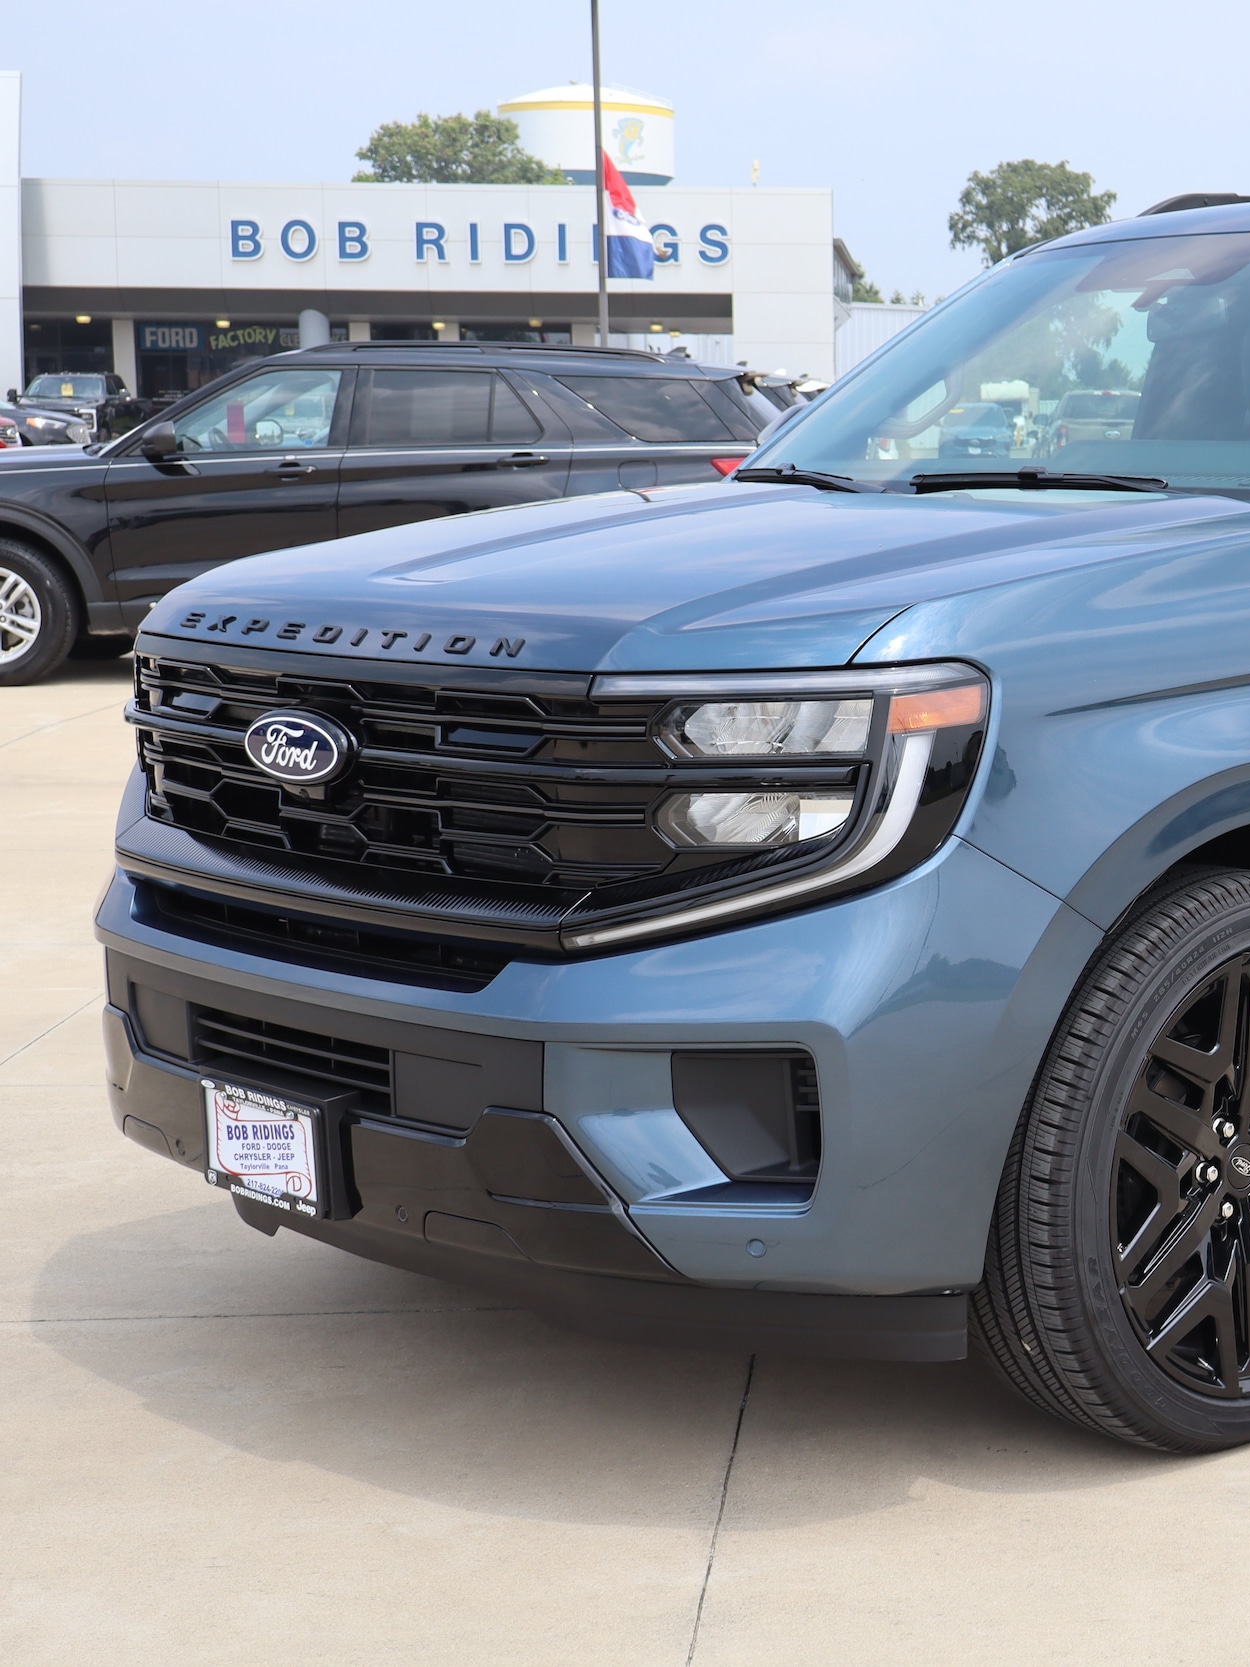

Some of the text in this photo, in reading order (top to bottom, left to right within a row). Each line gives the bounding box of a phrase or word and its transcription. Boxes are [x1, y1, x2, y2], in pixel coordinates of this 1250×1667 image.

[230, 218, 730, 263] BOB RIDIGS
[145, 327, 198, 348] FORD
[209, 326, 276, 350] FACTORY
[179, 612, 526, 658] EXPEDITION
[260, 723, 319, 772] Ford
[1153, 945, 1205, 1002] 285/40R24
[1212, 927, 1233, 944] 112H
[225, 1084, 246, 1099] BOB
[247, 1091, 287, 1112] RIDINGS
[226, 1124, 295, 1141] BOB RIDINGS
[234, 1153, 272, 1161] CHRYSLER
[277, 1153, 295, 1161] JEEP
[241, 1143, 261, 1151] FORD
[266, 1143, 292, 1151] DODGE
[240, 1163, 270, 1172] Taylorville
[230, 1184, 291, 1211] BOBRIDINGS.COM
[296, 1200, 317, 1216] Jeep
